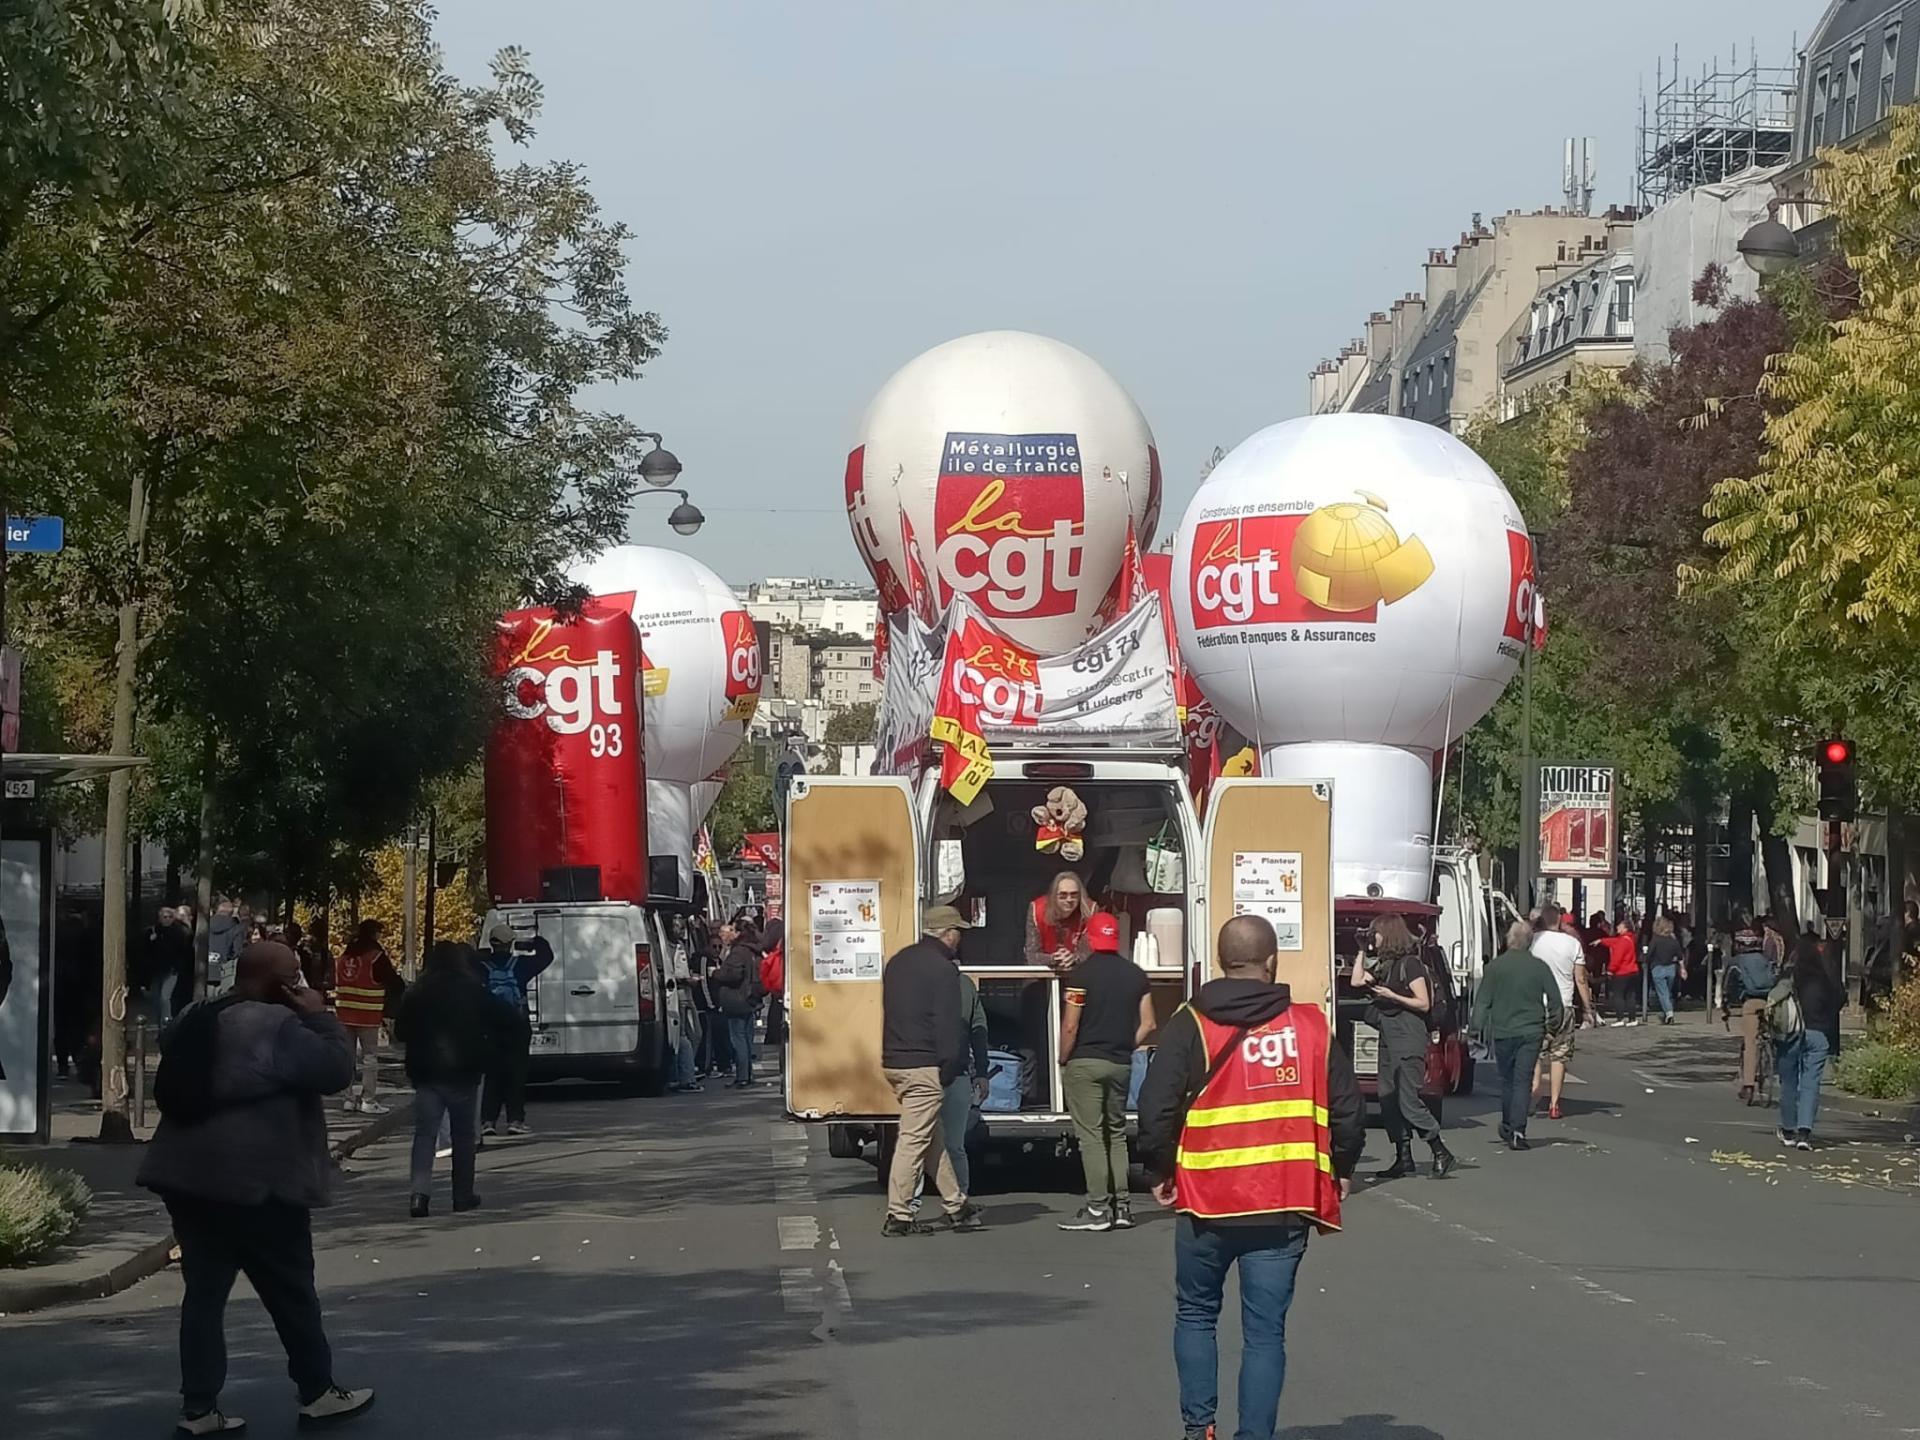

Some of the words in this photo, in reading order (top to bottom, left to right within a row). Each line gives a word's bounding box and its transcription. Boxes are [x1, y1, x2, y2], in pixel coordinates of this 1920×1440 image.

[948, 458, 975, 472] ile
[982, 459, 1007, 473] de
[1014, 459, 1080, 473] france
[949, 440, 1077, 461] Métallurgie
[946, 479, 1050, 535] la
[1257, 499, 1315, 513] ensemble
[1201, 521, 1262, 566] la
[937, 520, 1084, 612] cgt
[1196, 548, 1280, 622] cgt
[661, 610, 672, 618] LE
[508, 620, 596, 668] la
[1072, 643, 1114, 674] cgt
[1115, 629, 1141, 657] 78
[1197, 631, 1240, 649] Fédération
[1240, 630, 1288, 646] Banques
[1290, 629, 1300, 642] &
[1303, 628, 1377, 643] Assurances
[965, 645, 1012, 679] la
[1002, 648, 1034, 677] 78
[503, 650, 622, 735] cgt
[952, 658, 1044, 726] cgt
[589, 722, 623, 758] 93
[1543, 767, 1612, 793] NOIRES
[1267, 906, 1286, 914] Café
[846, 936, 866, 944] Café
[1242, 1026, 1298, 1068] cgt
[1275, 1066, 1297, 1082] 93
